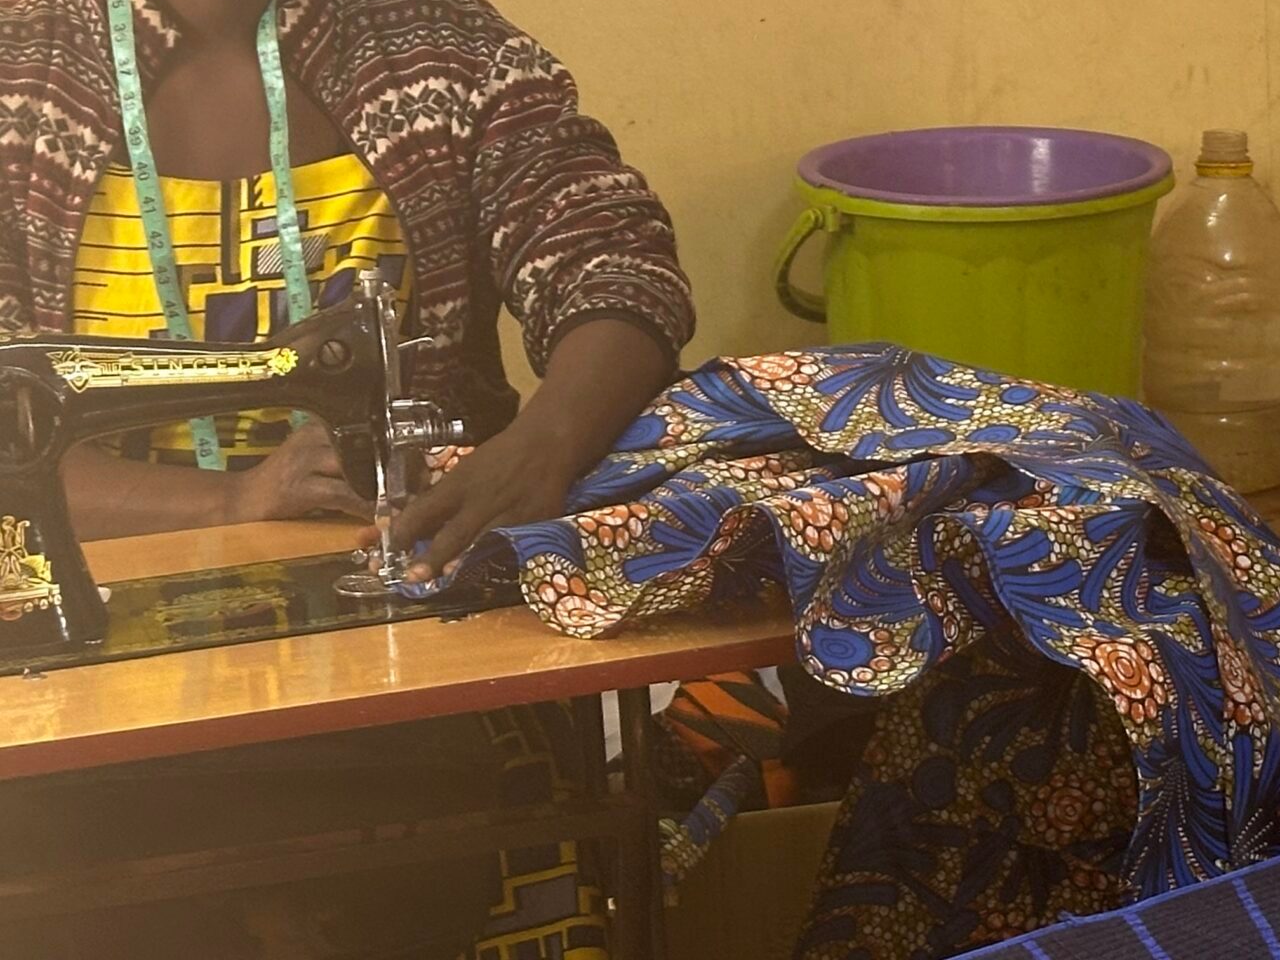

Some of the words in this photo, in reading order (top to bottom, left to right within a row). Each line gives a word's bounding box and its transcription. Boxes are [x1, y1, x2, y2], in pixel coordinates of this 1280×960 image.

[136, 162, 151, 181] 40
[143, 196, 158, 214] 41
[150, 230, 165, 249] 42
[165, 300, 180, 318] 44
[130, 357, 254, 376] SINGER
